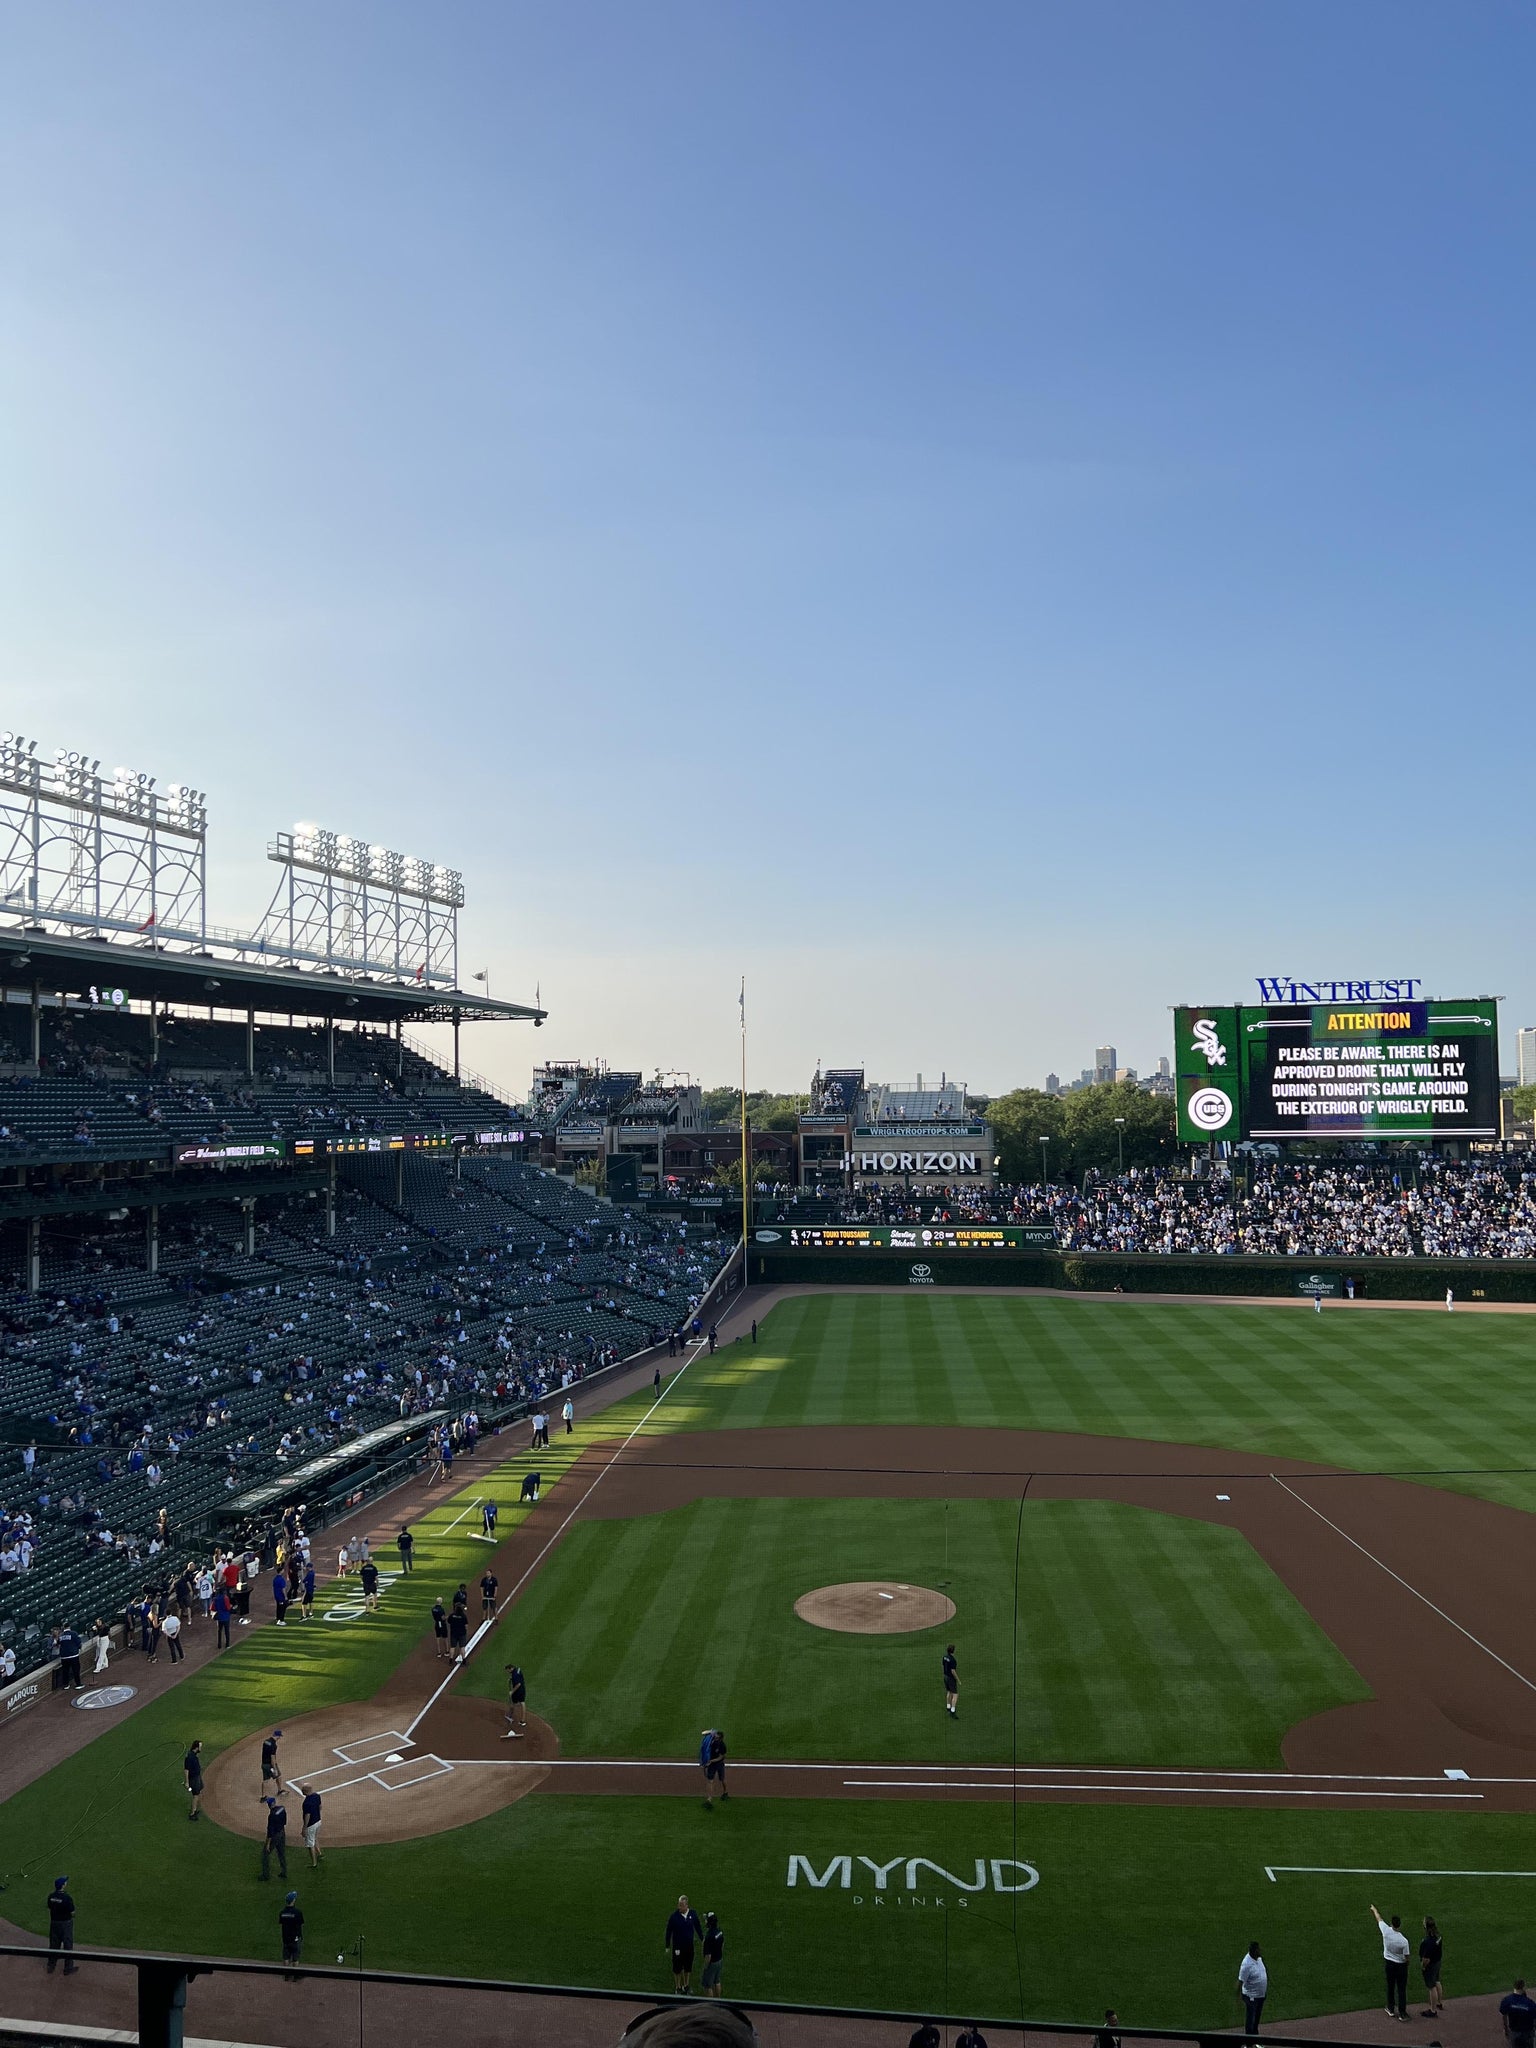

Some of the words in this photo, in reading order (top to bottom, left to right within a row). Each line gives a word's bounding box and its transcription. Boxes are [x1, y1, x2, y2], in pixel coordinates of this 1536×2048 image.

[1327, 1011, 1411, 1030] ATTENTION
[1278, 1047, 1322, 1062] PLEASE
[1323, 1046, 1340, 1060] BE
[1341, 1046, 1386, 1061] AWARE,
[1387, 1045, 1426, 1059] THERE
[1427, 1045, 1440, 1058] IS
[1441, 1044, 1459, 1058] AN
[1273, 1065, 1335, 1079] APPROVED
[1337, 1064, 1378, 1078] DRONE
[1378, 1063, 1411, 1077] THAT
[1411, 1063, 1445, 1077] WILL
[1445, 1062, 1466, 1076] FLY
[1272, 1084, 1317, 1098] DURING
[1382, 1082, 1417, 1096] GAME
[1418, 1081, 1469, 1095] AROUND
[1276, 1101, 1299, 1115] THE
[1300, 1101, 1358, 1115] EXTERIOR
[1359, 1100, 1375, 1114] OF
[1376, 1100, 1430, 1114] WRIGLEY
[1431, 1099, 1469, 1114] FIELD.
[869, 1127, 969, 1136] WRIGLEYROOFTOPS.COM
[226, 1146, 249, 1157] WRIGLEY
[250, 1145, 264, 1156] FIELD
[862, 1152, 976, 1170] HORIZON
[801, 1230, 812, 1239] 47
[840, 1230, 870, 1239] TOUSSAINT
[890, 1229, 917, 1239] Starting
[956, 1231, 971, 1239] KYLE
[971, 1231, 1004, 1240] HENDRICKS
[1025, 1232, 1053, 1240] MYND
[890, 1238, 917, 1247] Pitchers
[1298, 1282, 1335, 1290] Gallagher
[7, 1684, 39, 1711] MARQUEE
[786, 1854, 1040, 1892] MYND
[853, 1895, 968, 1908] DRINKS
